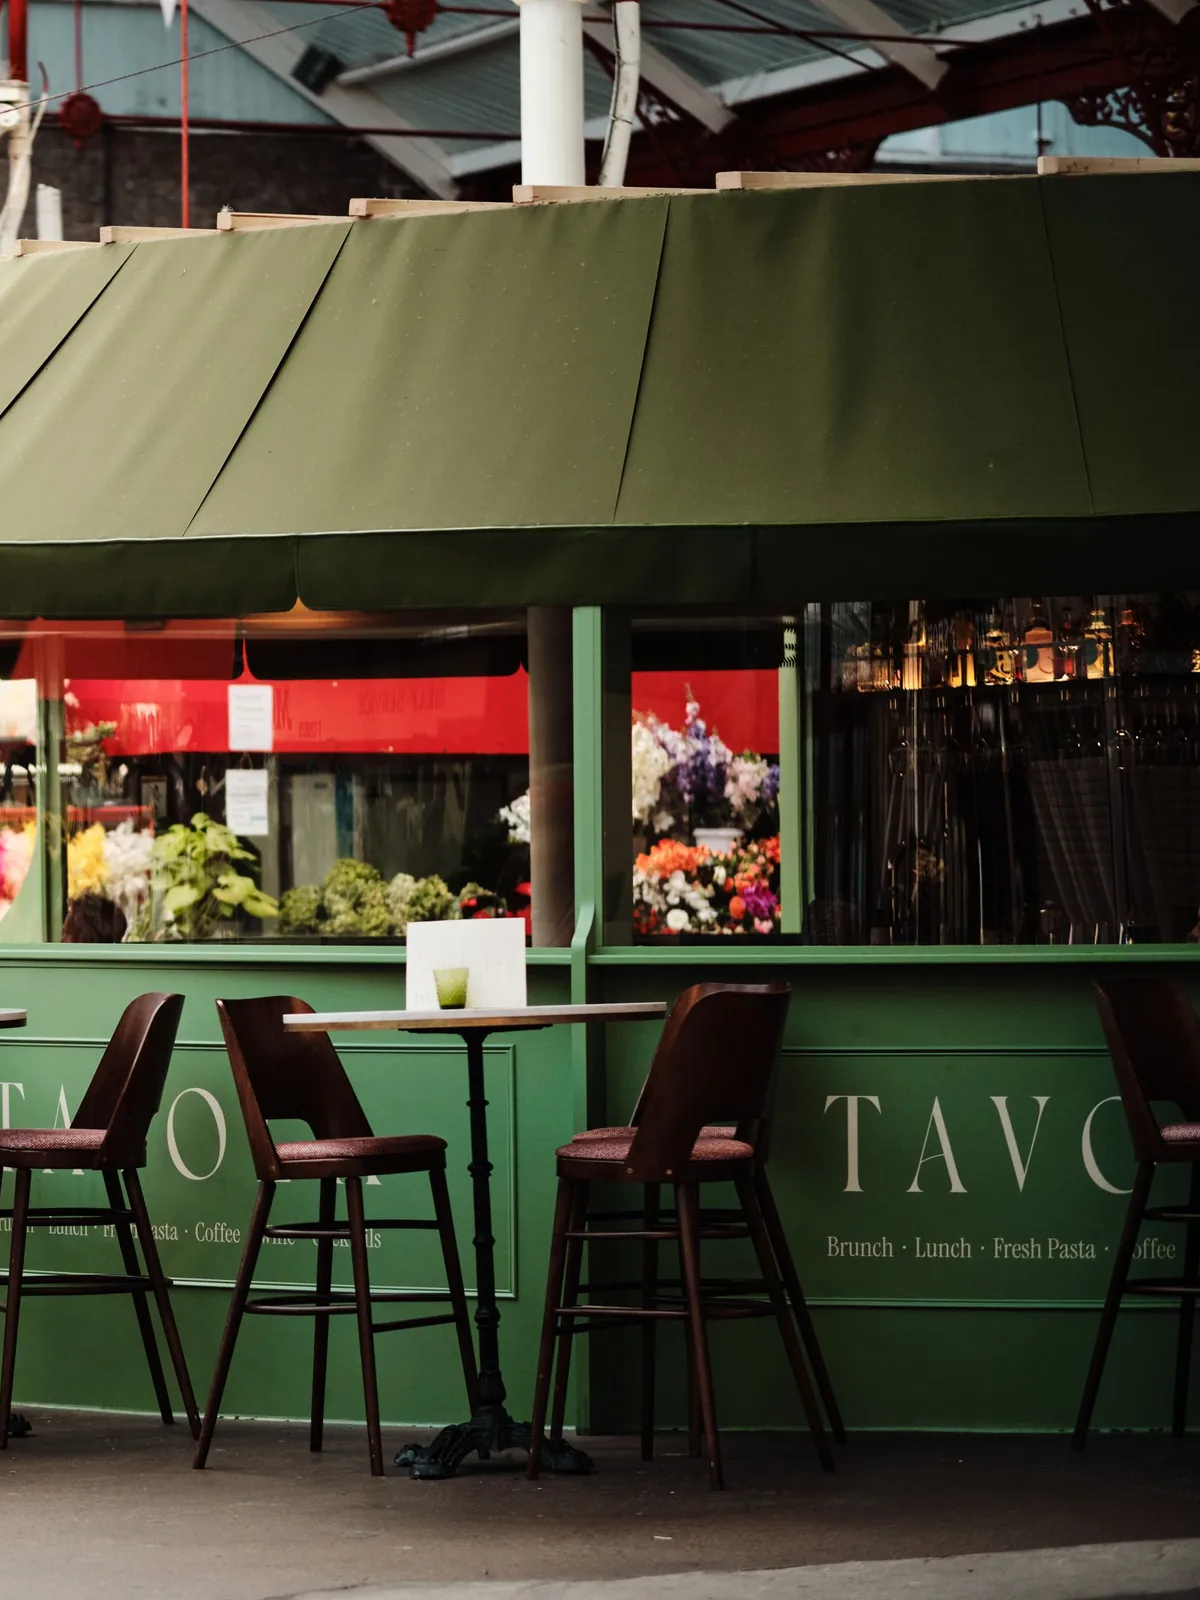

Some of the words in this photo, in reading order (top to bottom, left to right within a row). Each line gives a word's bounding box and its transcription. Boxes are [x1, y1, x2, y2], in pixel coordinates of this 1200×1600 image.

[151, 1222, 179, 1241] asta
[195, 1221, 241, 1244] Coffee
[827, 1236, 894, 1259] Brunch
[915, 1236, 972, 1259] Lunch
[993, 1236, 1042, 1259] Fresh
[1047, 1236, 1097, 1260] Pasta
[1133, 1237, 1177, 1260] offee
